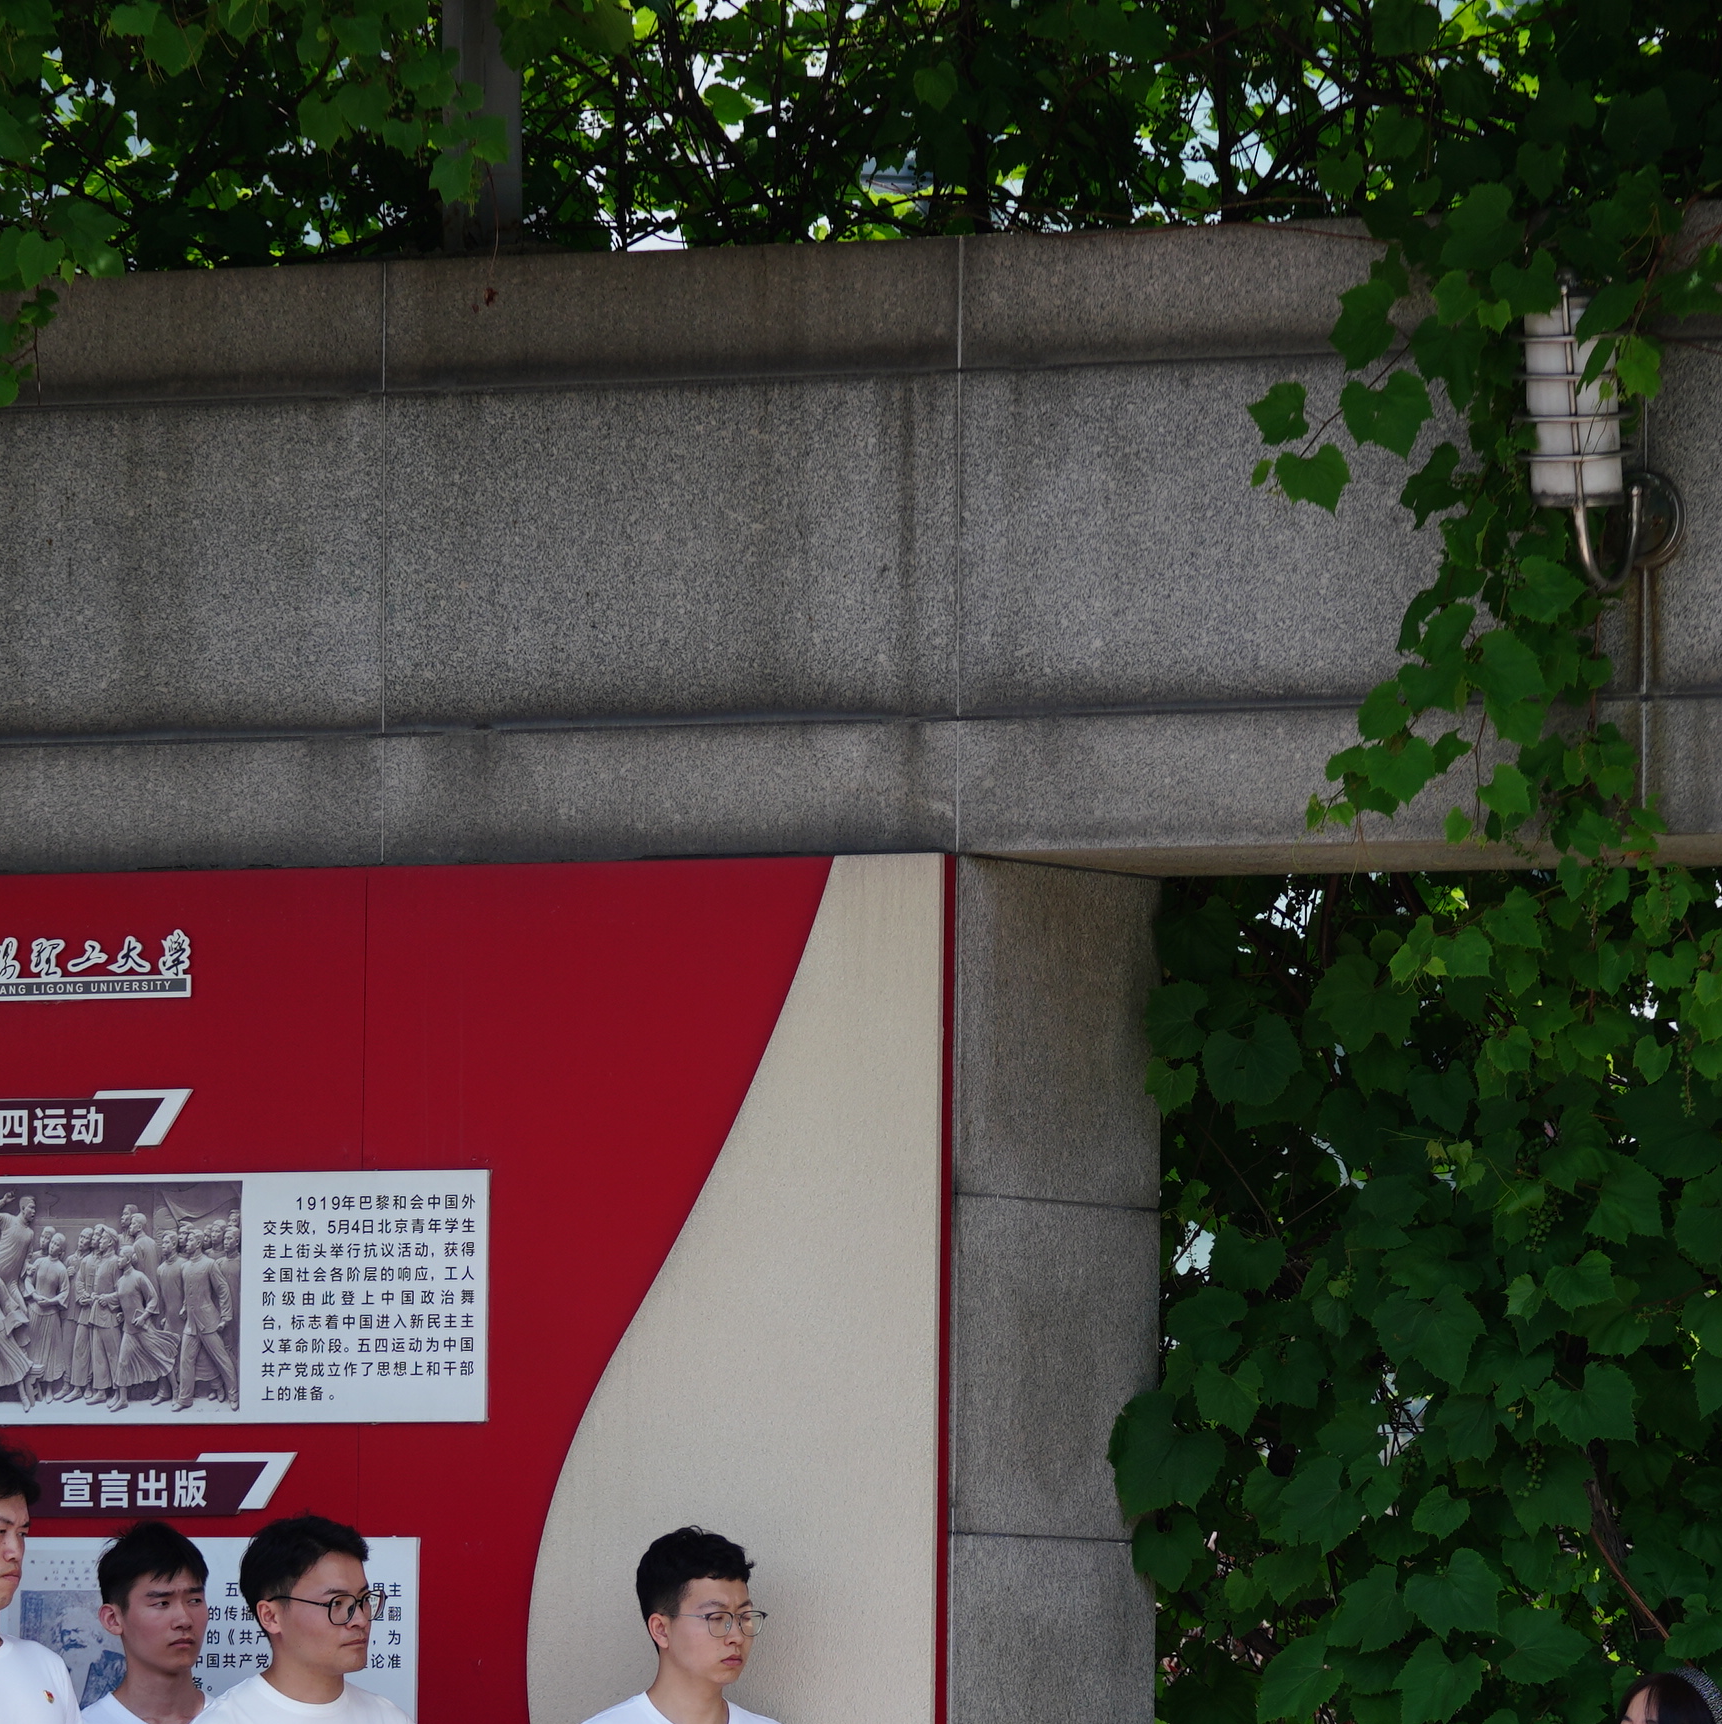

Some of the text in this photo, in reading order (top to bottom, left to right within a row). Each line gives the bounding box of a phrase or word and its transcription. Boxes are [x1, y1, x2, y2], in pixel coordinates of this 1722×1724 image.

[33, 983, 84, 994] LIGONG
[90, 980, 172, 992] UNIVERSITY
[296, 1194, 476, 1211] 1919年巴黎和会中国外
[263, 1218, 476, 1235] 交失败，5月4日北京青年学生
[263, 1242, 476, 1259] 走上街头举行抗议活动，获得
[262, 1266, 475, 1283] 全国社会各阶层的响应，工人
[262, 1289, 475, 1307] 阶级由此登上中国政治舞
[262, 1313, 474, 1331] 台，标志着中国进入新民主主
[261, 1336, 474, 1354] 义革命阶段。五四运动为中国
[261, 1360, 474, 1378] 共产党成立作了思想上和干部
[261, 1386, 335, 1401] 上的准备。
[60, 1469, 207, 1508] 宣言出版
